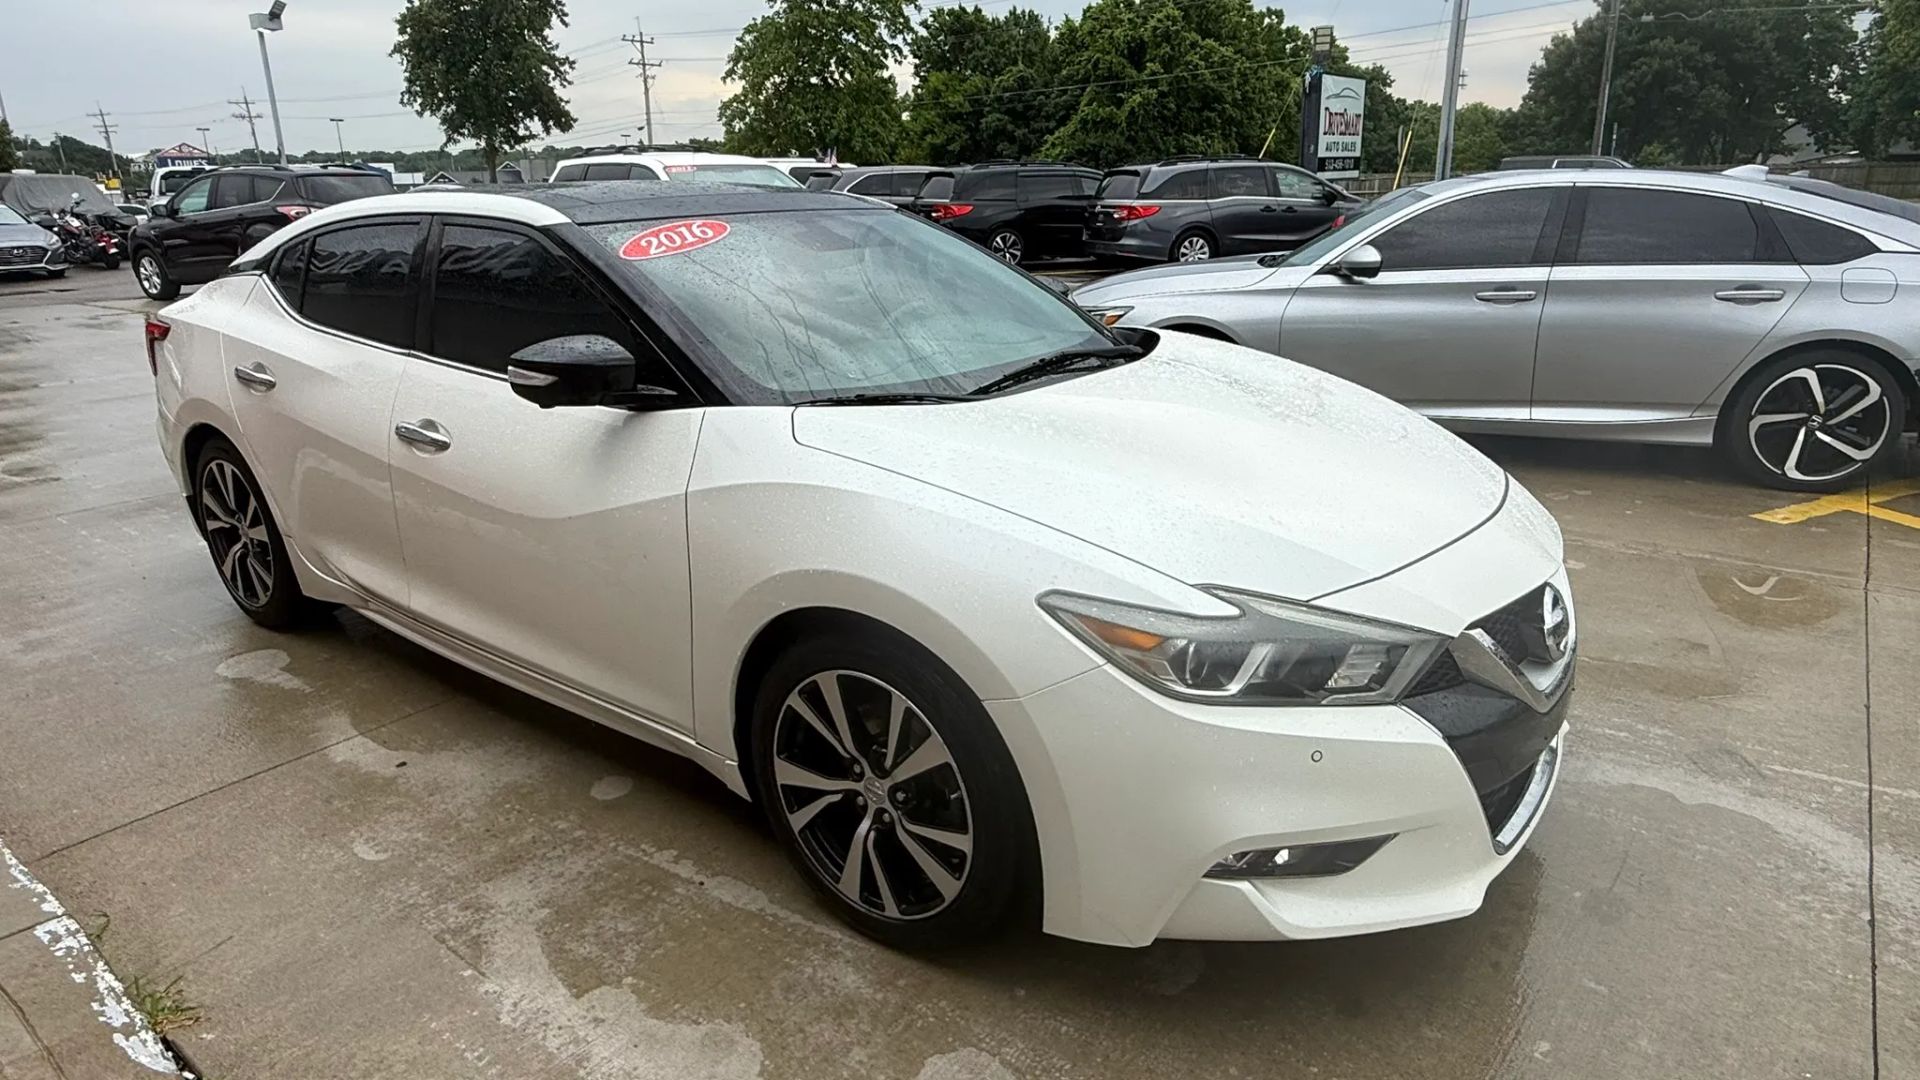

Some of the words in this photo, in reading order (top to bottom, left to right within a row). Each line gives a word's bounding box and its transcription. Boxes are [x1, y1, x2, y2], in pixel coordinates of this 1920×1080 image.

[1325, 141, 1340, 152] AUTO
[1341, 141, 1357, 152] SALES
[640, 222, 714, 255] 2016
